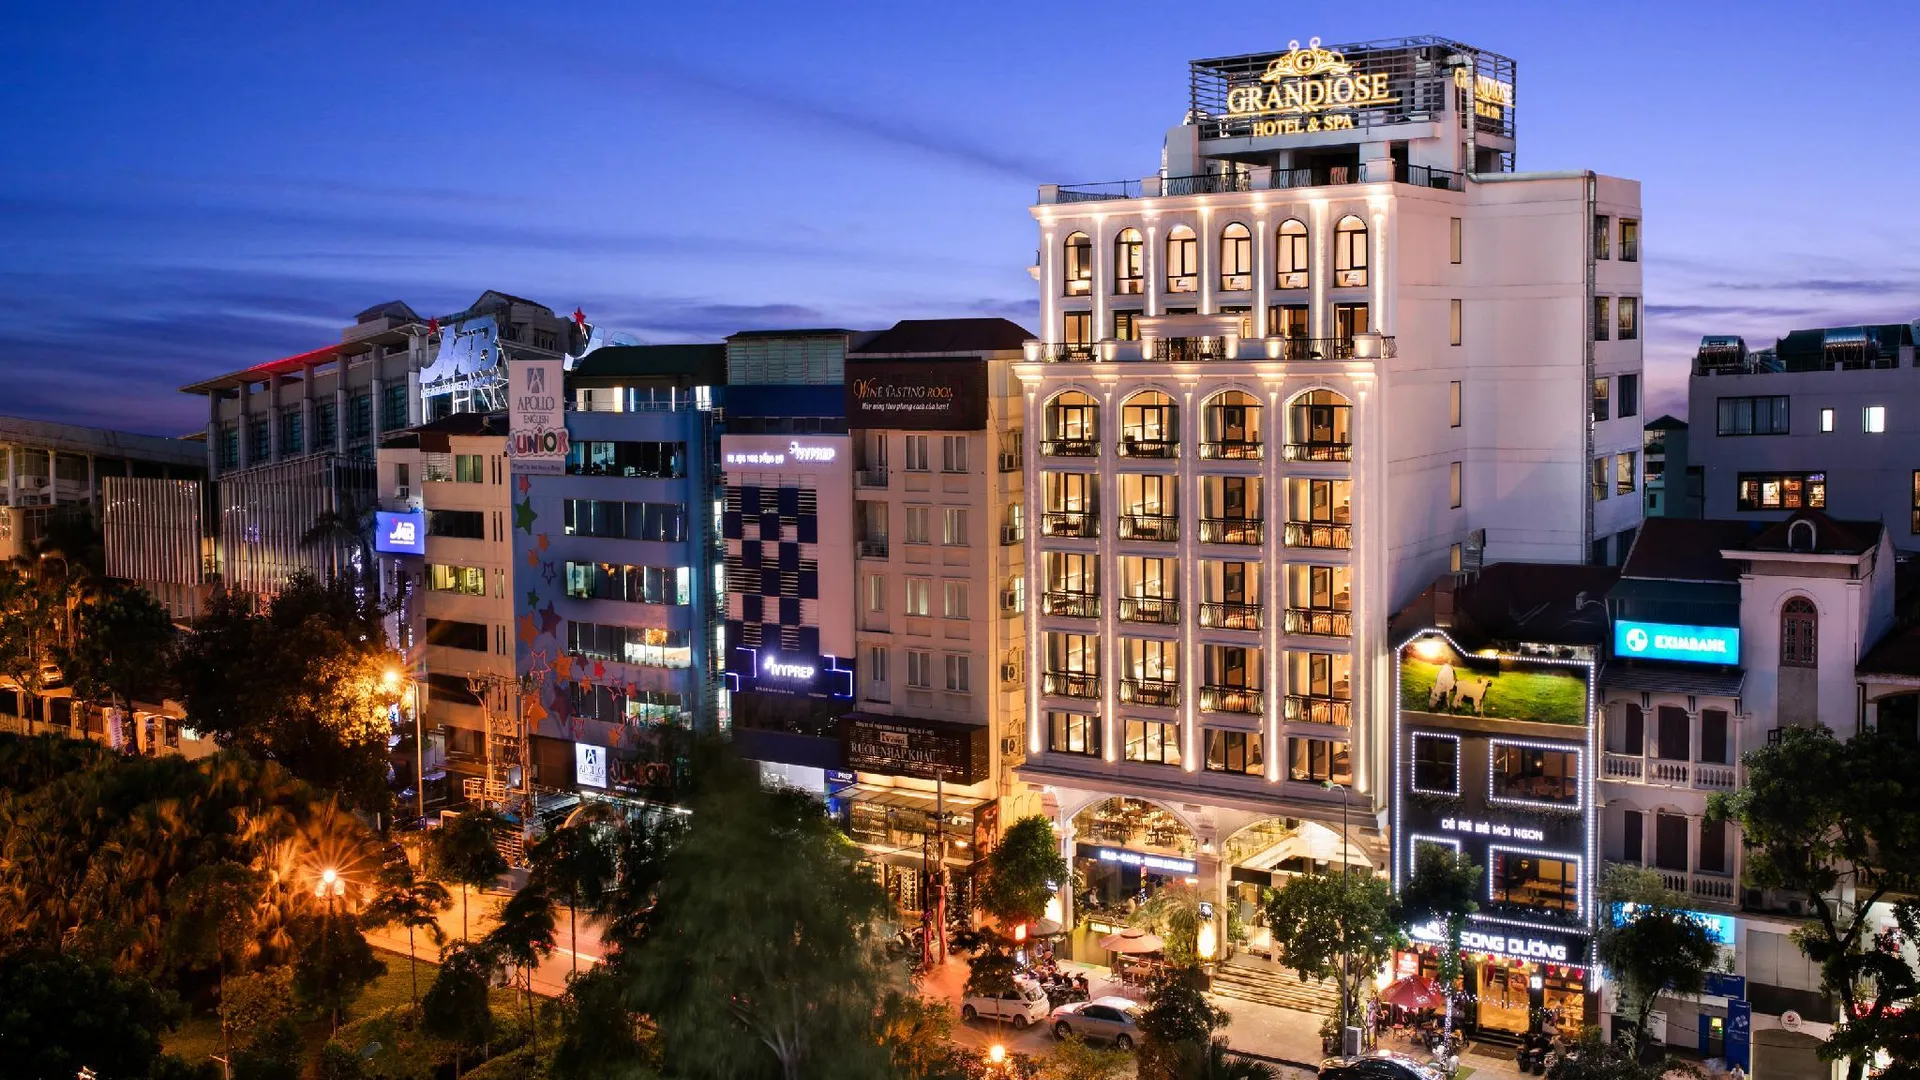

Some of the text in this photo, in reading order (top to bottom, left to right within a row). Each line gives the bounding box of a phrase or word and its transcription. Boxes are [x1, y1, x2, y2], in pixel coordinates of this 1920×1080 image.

[1227, 73, 1389, 113] GRANDIOSE
[1253, 114, 1354, 137] HOTEL & SPA
[853, 377, 883, 399] WINE
[885, 384, 925, 398] TASTING
[517, 396, 555, 411] APOLLO
[523, 414, 549, 424] ENGLISH
[1655, 635, 1726, 653] EXIMBANK
[771, 664, 814, 678] IVYPREP
[838, 772, 853, 780] PREP
[1514, 828, 1543, 841] NGON
[1459, 931, 1504, 952] SONG
